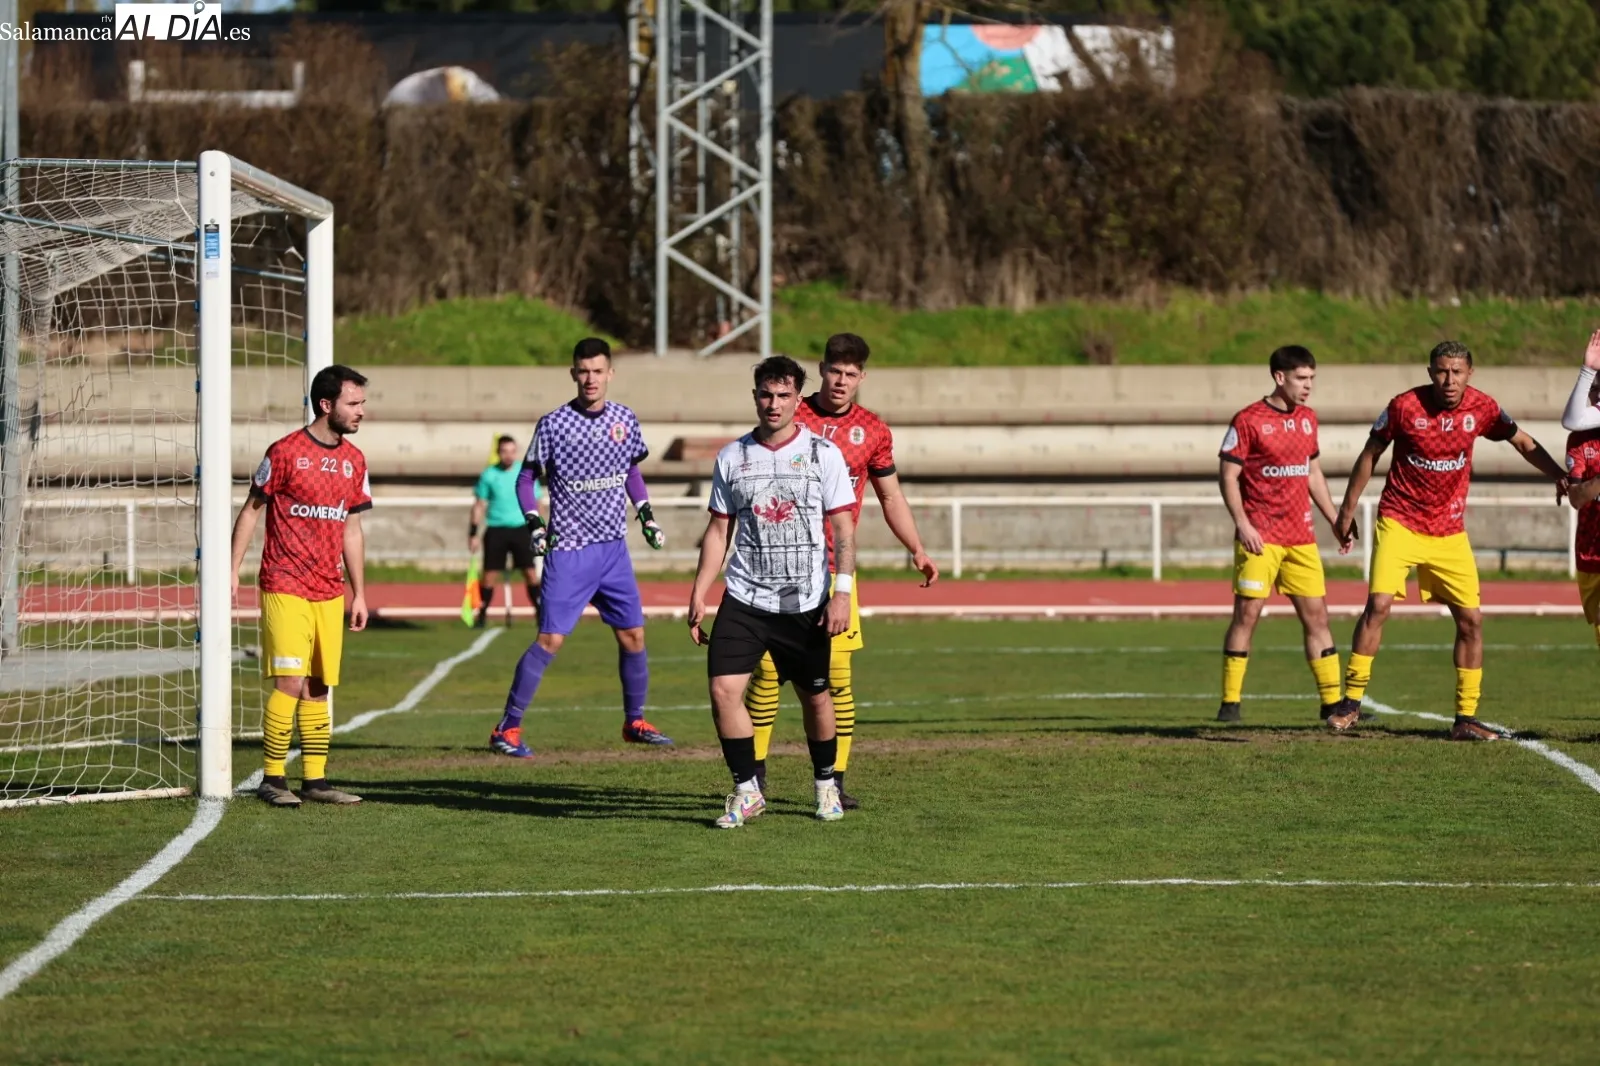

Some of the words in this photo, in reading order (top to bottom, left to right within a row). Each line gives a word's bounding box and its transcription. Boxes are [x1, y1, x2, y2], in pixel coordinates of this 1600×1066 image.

[822, 424, 838, 439] 17
[1283, 419, 1296, 433] 19
[1441, 417, 1454, 432] 12
[320, 457, 338, 473] 22
[1262, 455, 1310, 477] COMERDI
[567, 466, 628, 491] COMERDIST
